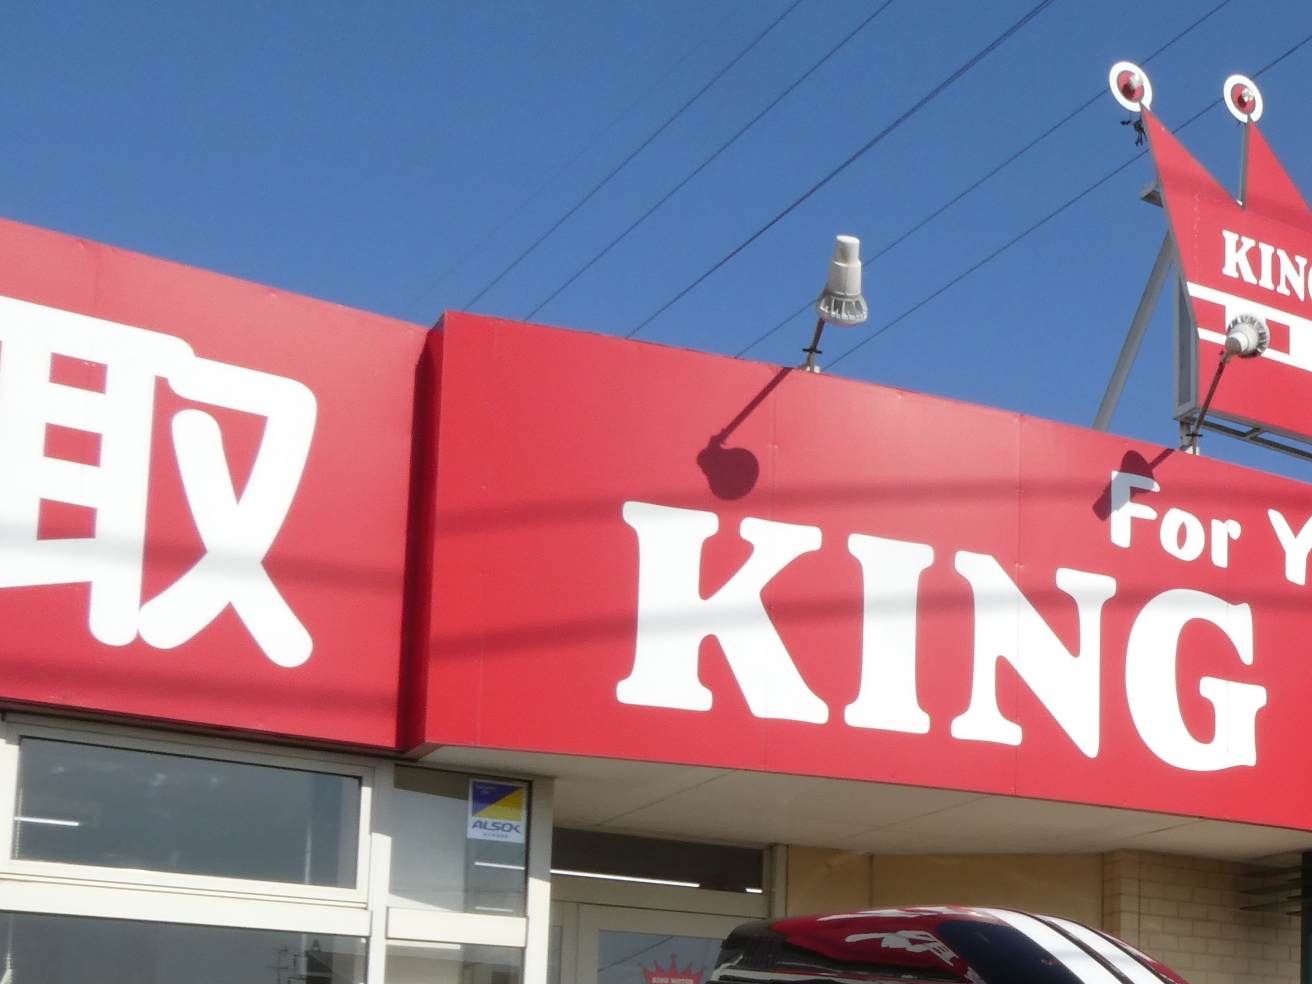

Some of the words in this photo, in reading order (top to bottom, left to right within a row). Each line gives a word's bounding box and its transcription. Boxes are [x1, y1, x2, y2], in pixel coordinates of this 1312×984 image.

[0, 297, 317, 667] 取
[1110, 470, 1241, 568] For
[616, 500, 1267, 772] KING
[472, 820, 521, 834] ALSOK
